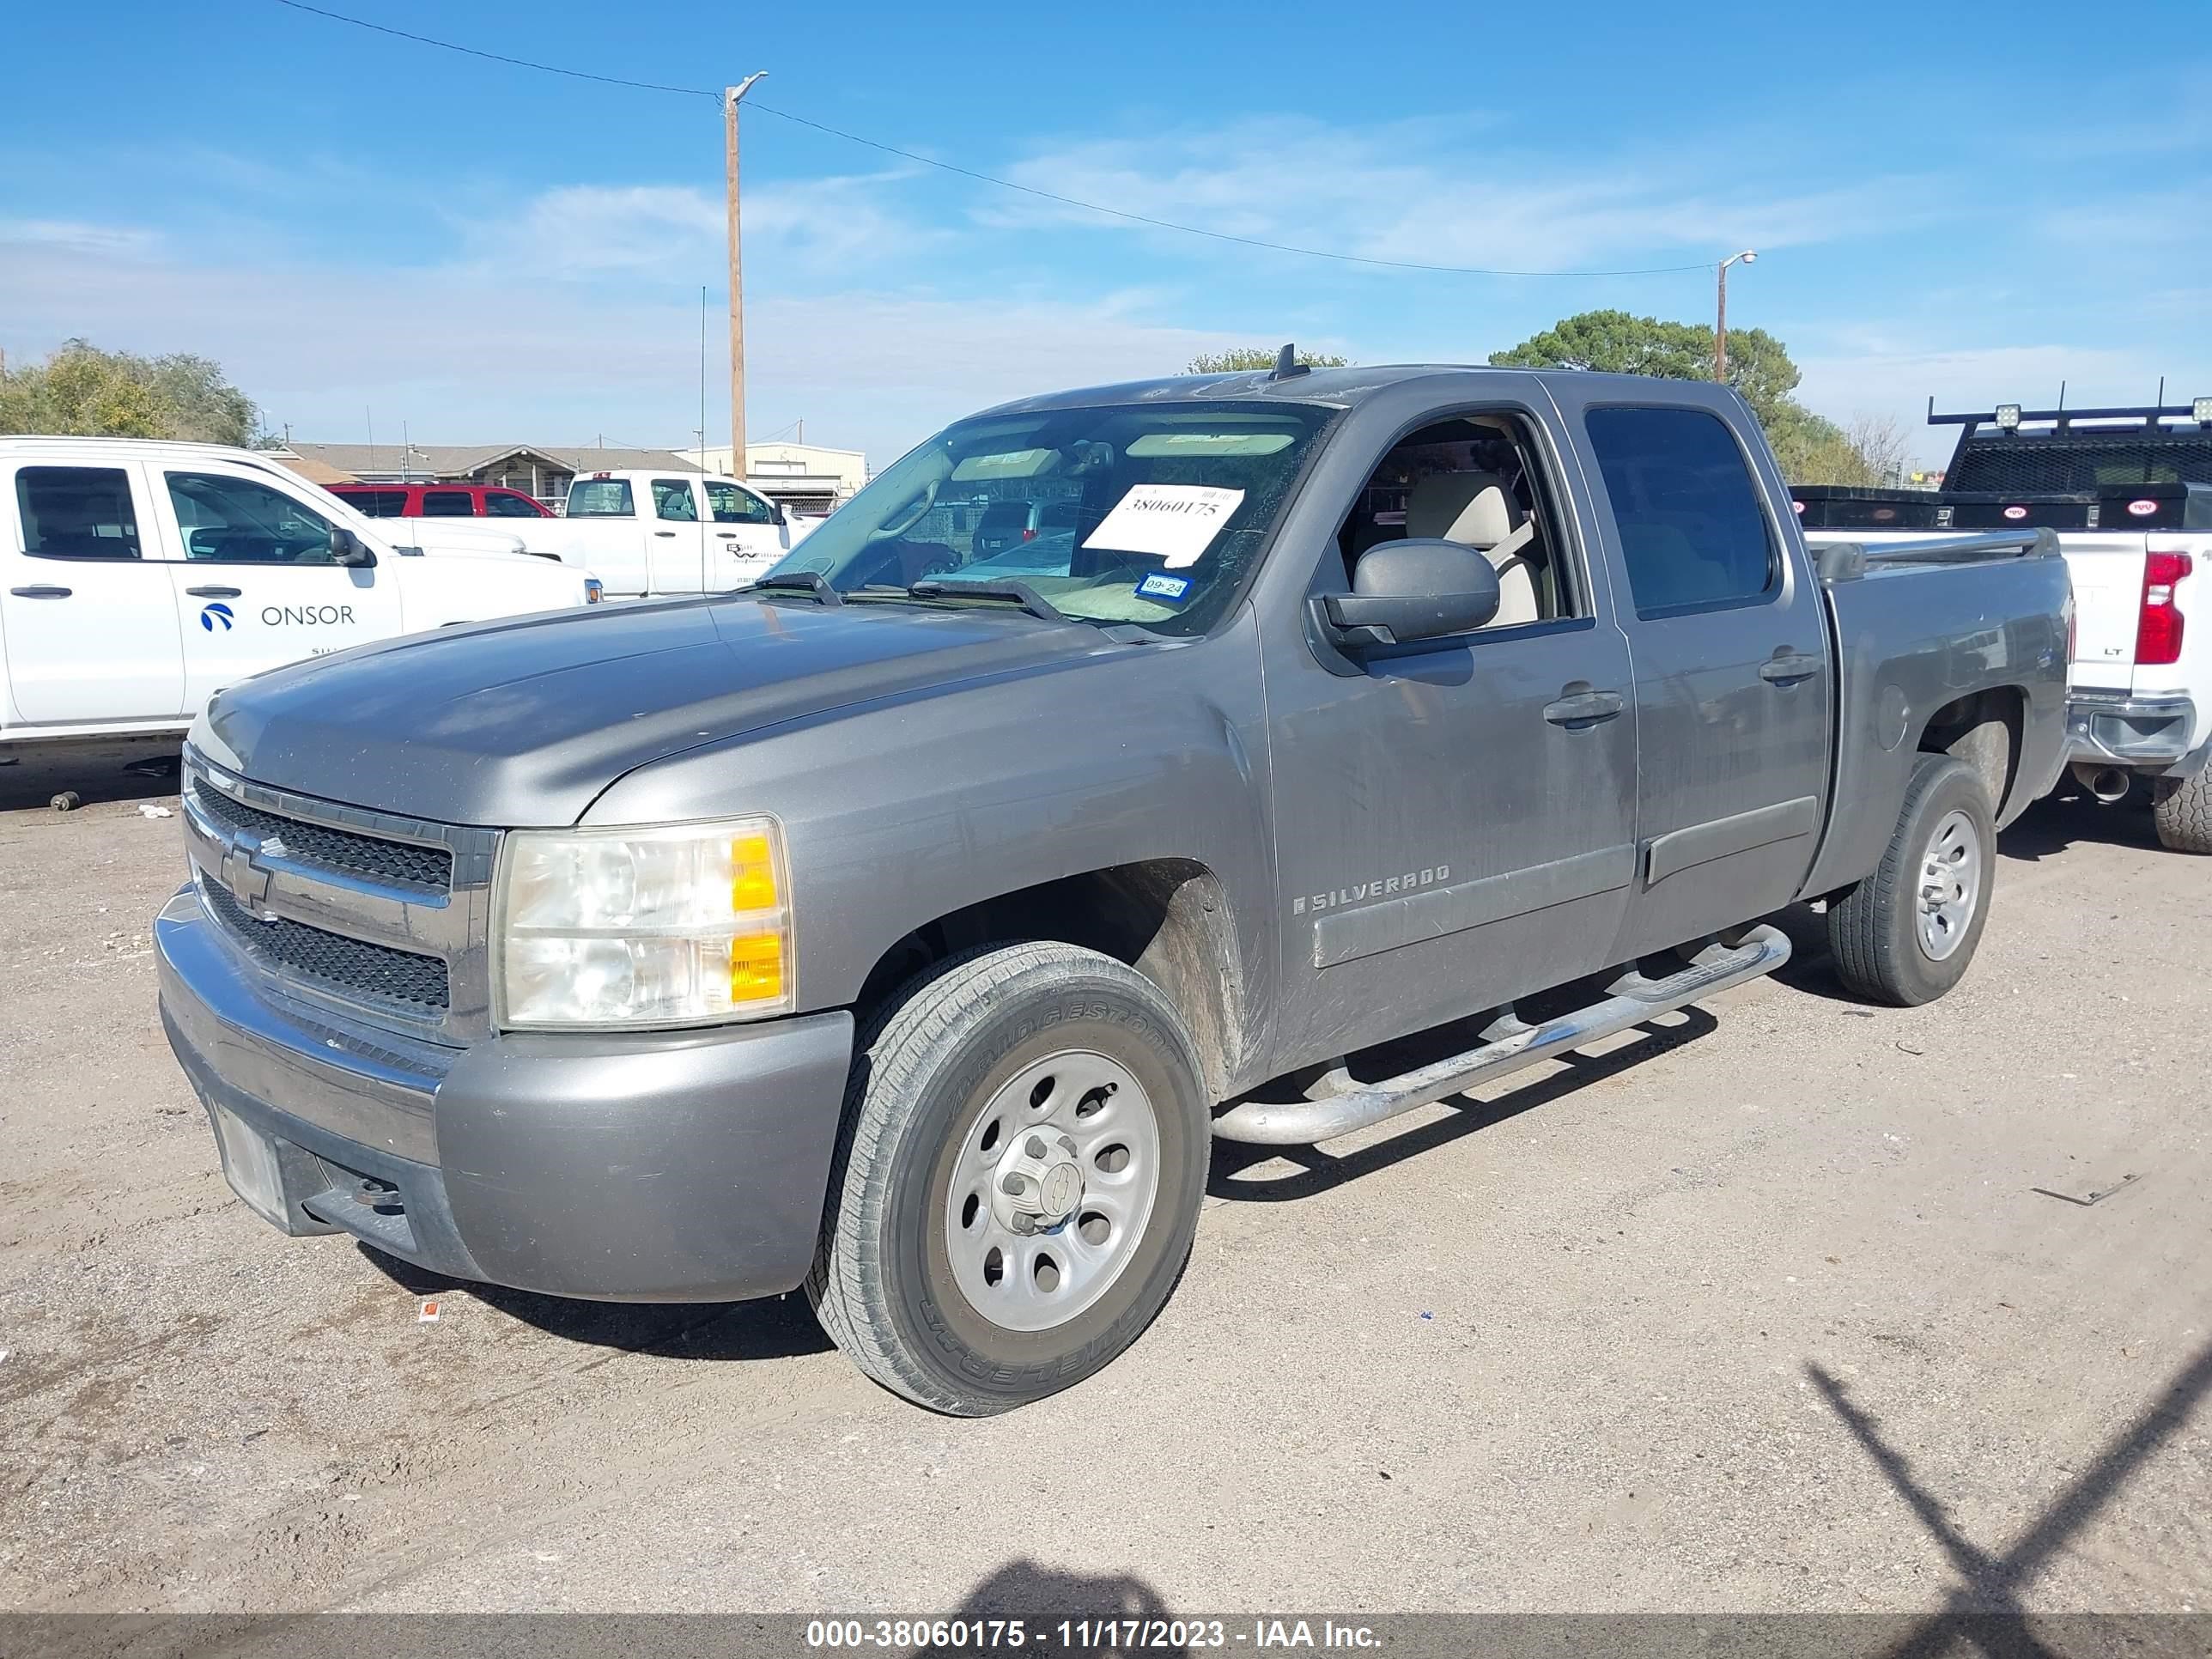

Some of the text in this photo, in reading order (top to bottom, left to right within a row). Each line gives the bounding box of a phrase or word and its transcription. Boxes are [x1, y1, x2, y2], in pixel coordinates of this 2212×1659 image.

[1127, 499, 1221, 516] 38060175
[1146, 580, 1182, 592] 09 24
[262, 605, 356, 626] ONSOR
[2104, 647, 2124, 657] LT
[1313, 866, 1450, 912] SILVERADO
